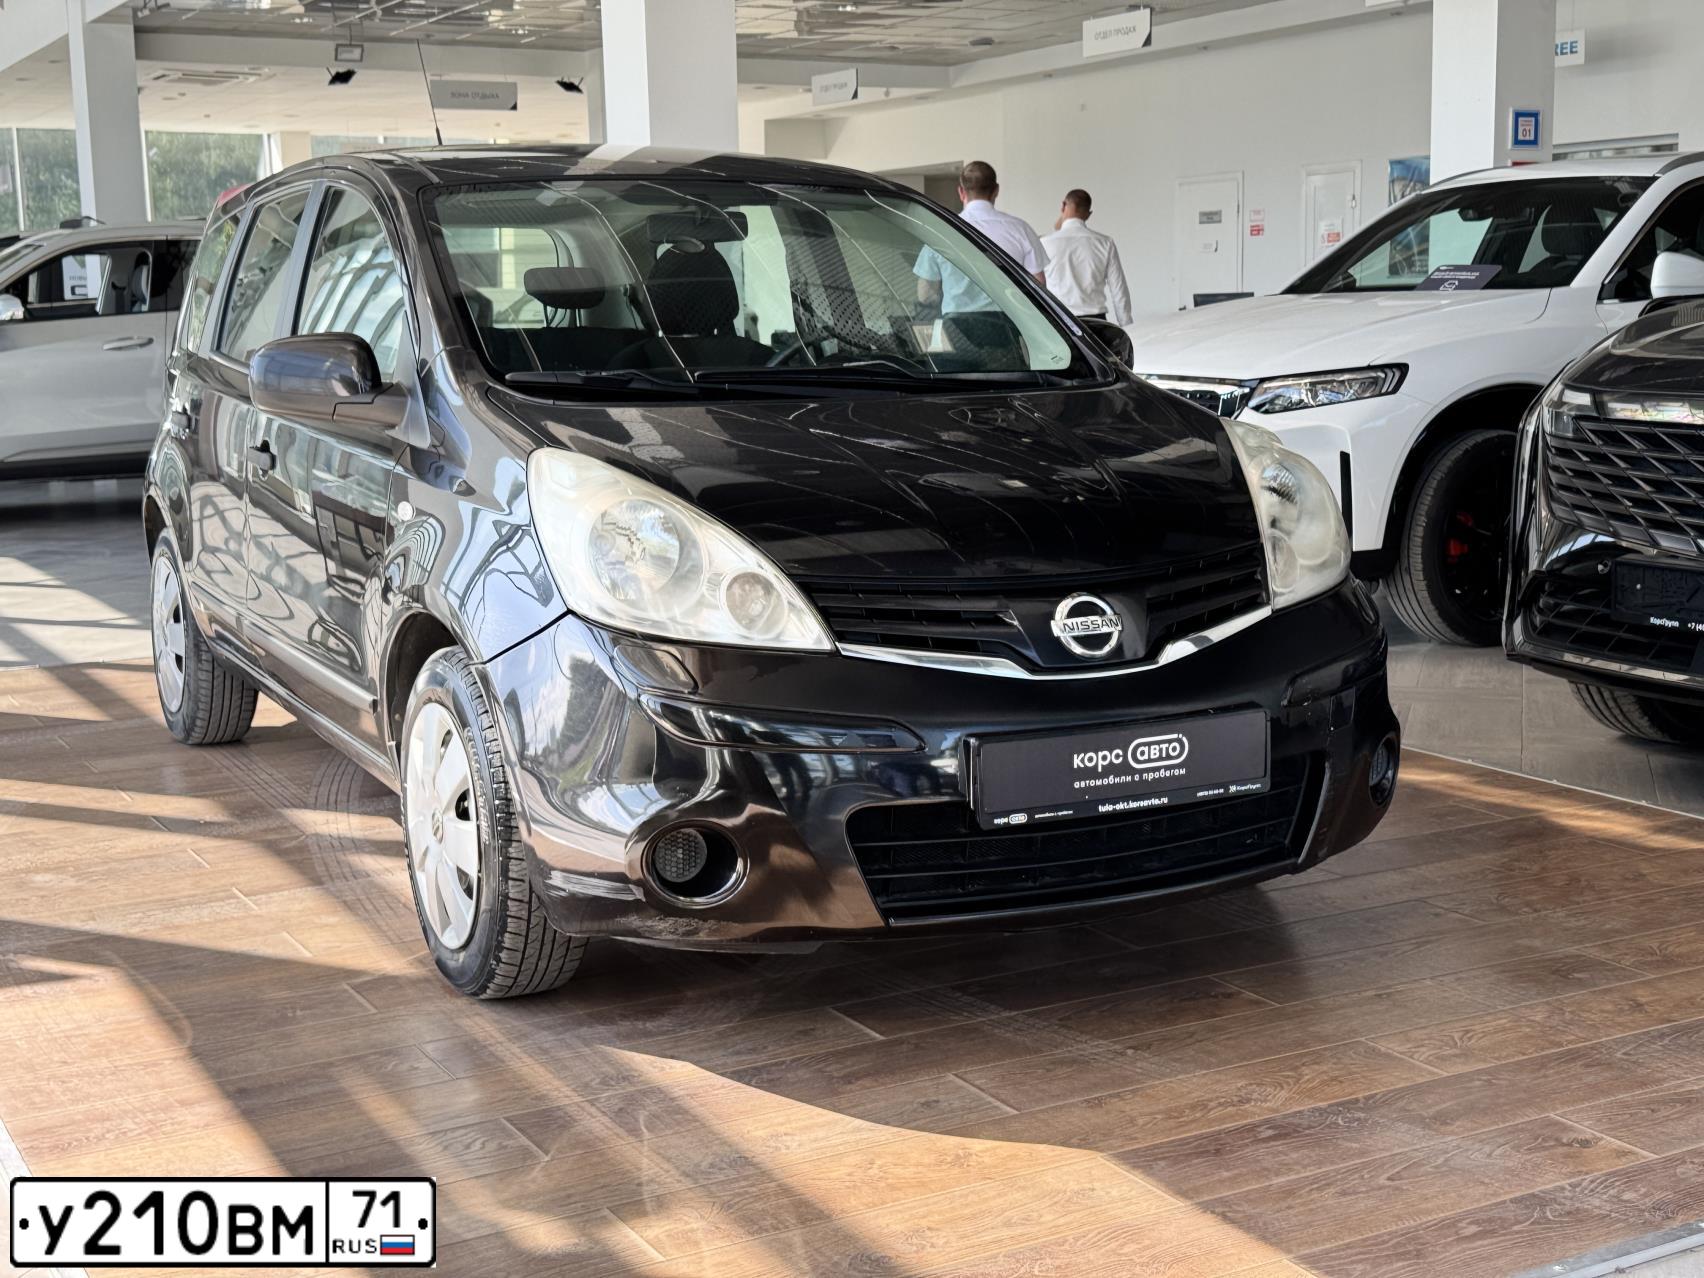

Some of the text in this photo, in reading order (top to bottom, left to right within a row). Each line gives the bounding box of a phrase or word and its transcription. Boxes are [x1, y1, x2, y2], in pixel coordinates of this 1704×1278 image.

[1063, 616, 1120, 632] NISSAN
[1073, 742, 1181, 772] корс авто
[1074, 775, 1132, 789] автомобили
[1142, 768, 1186, 781] пробегом
